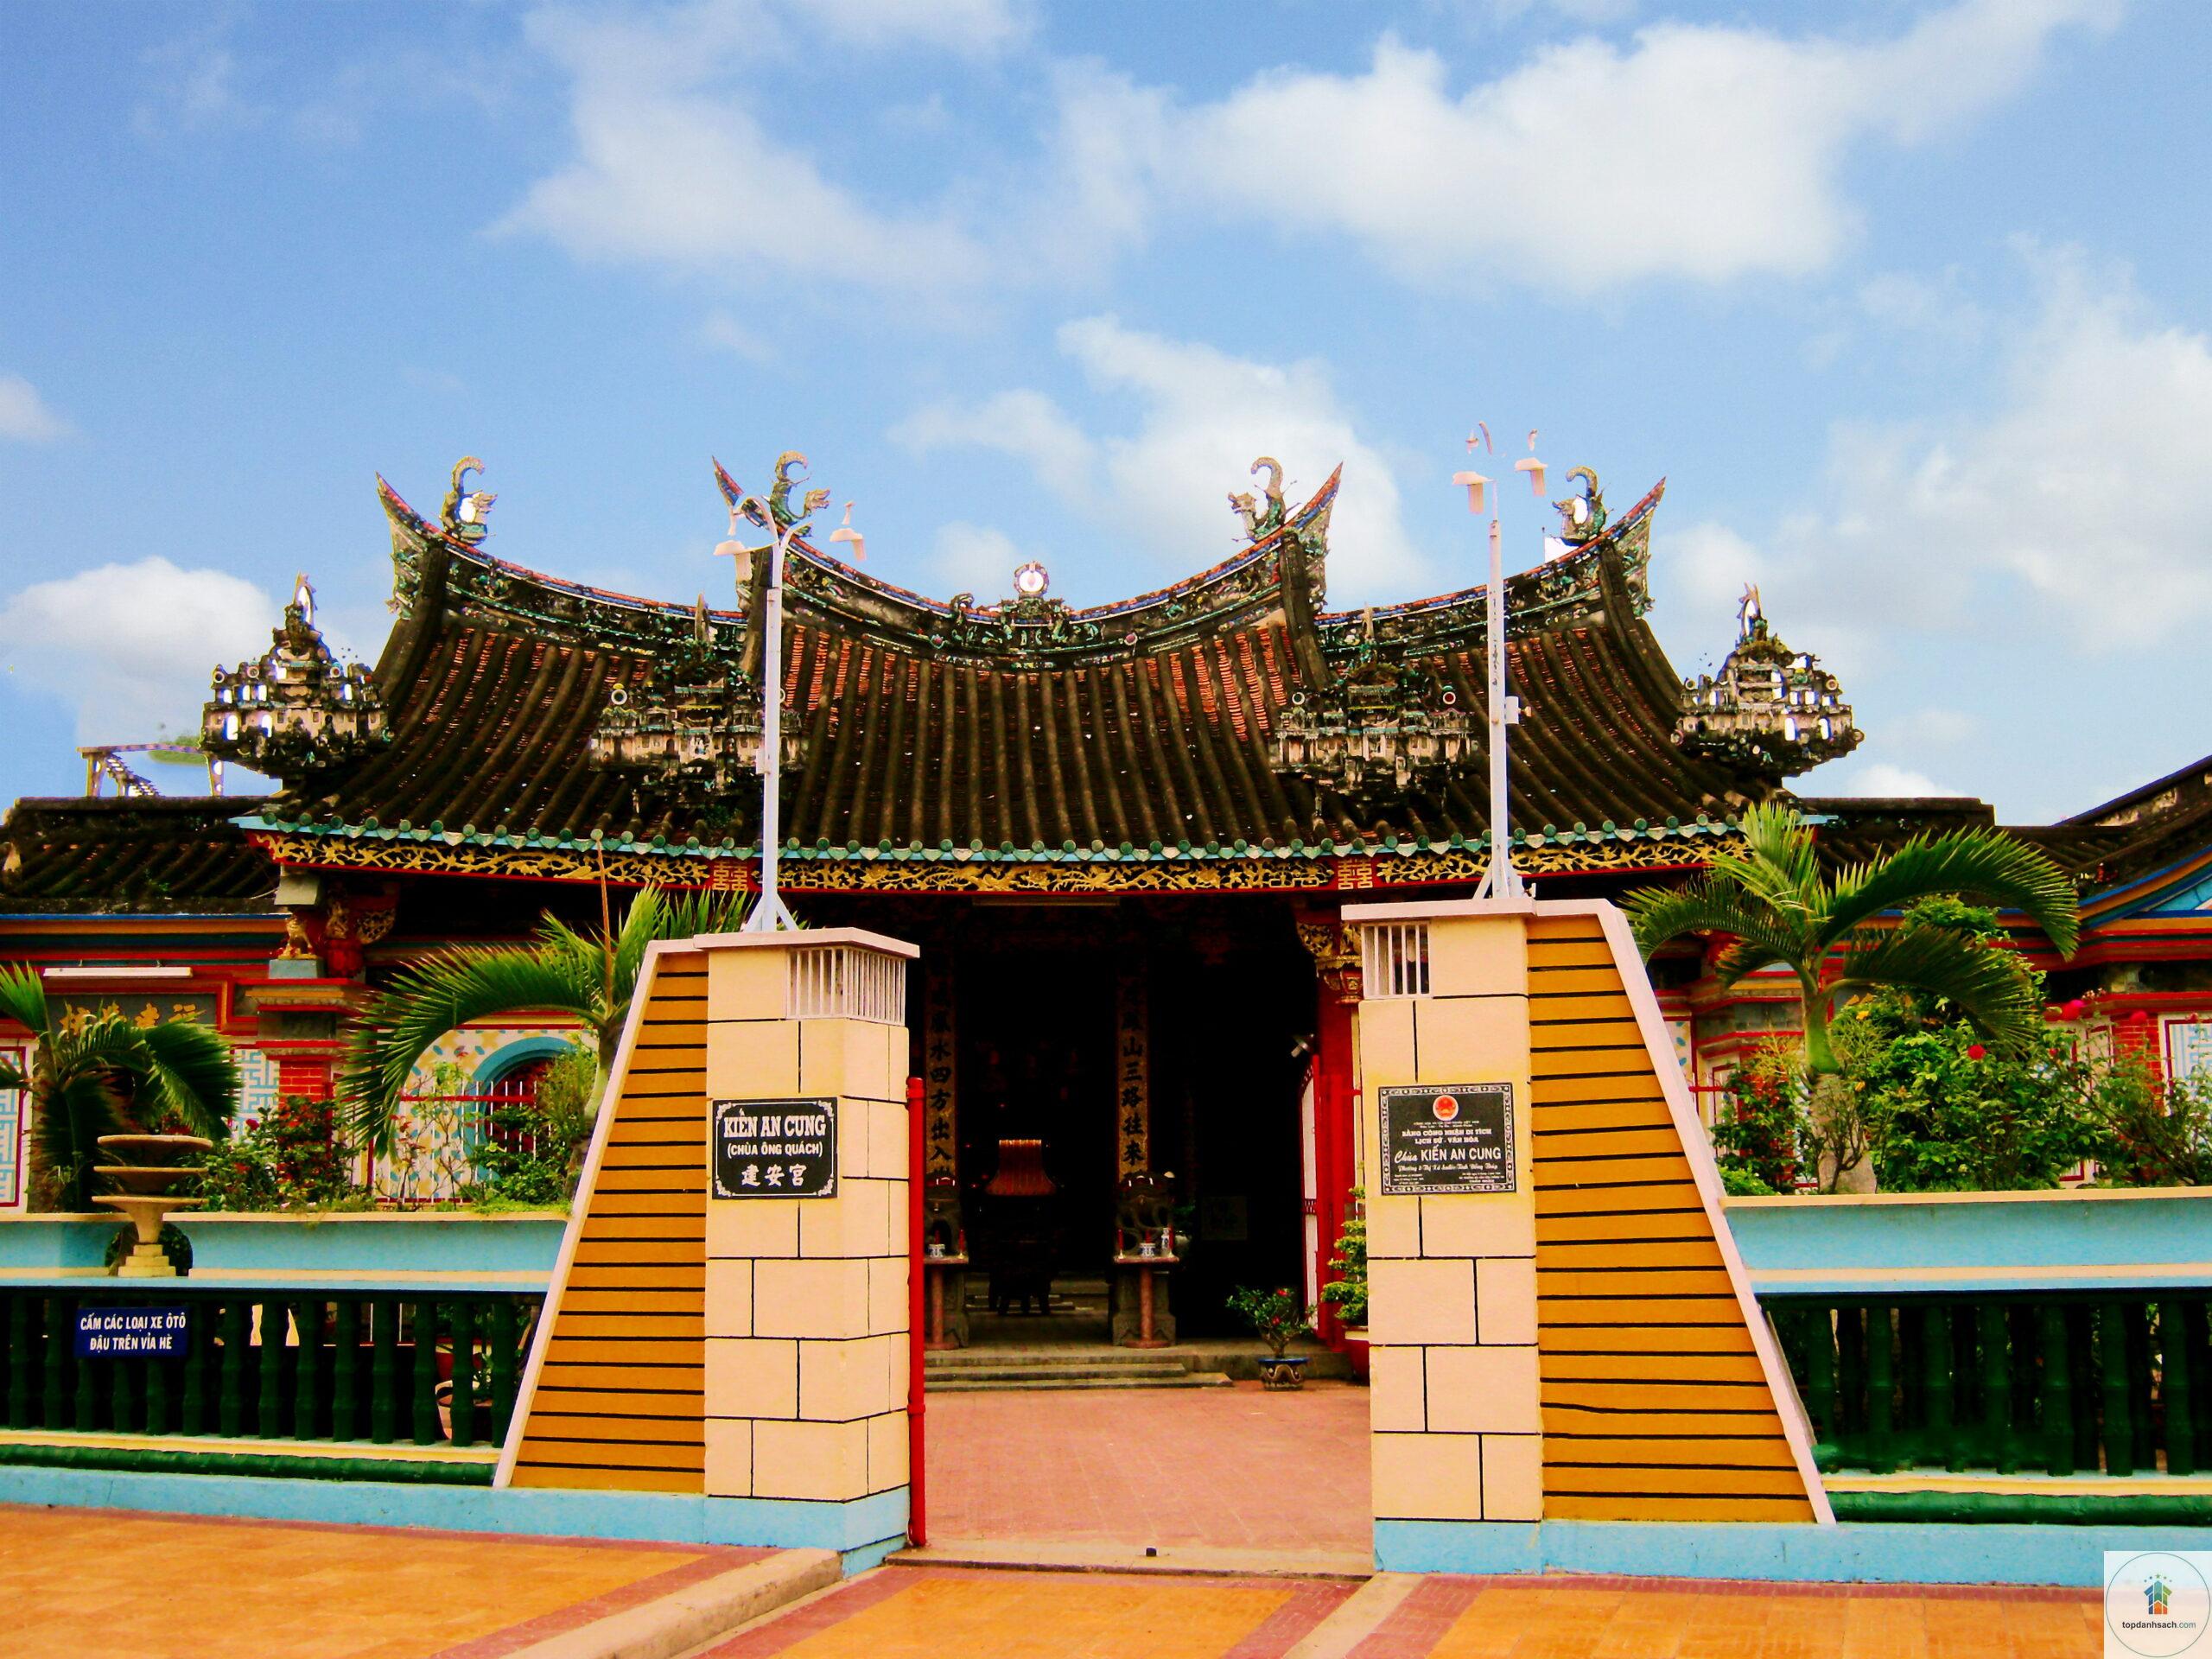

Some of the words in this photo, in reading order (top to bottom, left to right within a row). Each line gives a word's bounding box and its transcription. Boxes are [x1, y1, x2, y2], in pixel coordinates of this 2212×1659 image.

[930, 1011, 951, 1174] 水四方出入
[723, 1108, 758, 1138] KIẾN
[760, 1116, 781, 1137] AN
[784, 1115, 826, 1137] CUNG
[727, 1141, 759, 1159] (CHÙA
[760, 1141, 782, 1155] ÔNG
[785, 1141, 823, 1158] QUÁCH)
[1421, 1144, 1447, 1161] KIẾN
[1450, 1148, 1465, 1160] AN
[1469, 1147, 1502, 1160] CUNG
[80, 1313, 102, 1331] CẤM
[104, 1313, 124, 1330] CÁC
[125, 1316, 148, 1332] LOẠI
[150, 1316, 163, 1329] XE
[166, 1312, 186, 1329] ÔTÔ
[90, 1334, 110, 1353] ĐẬU
[112, 1333, 138, 1351] TRÊN
[141, 1332, 156, 1350] VỈA
[159, 1333, 173, 1350] HÈ
